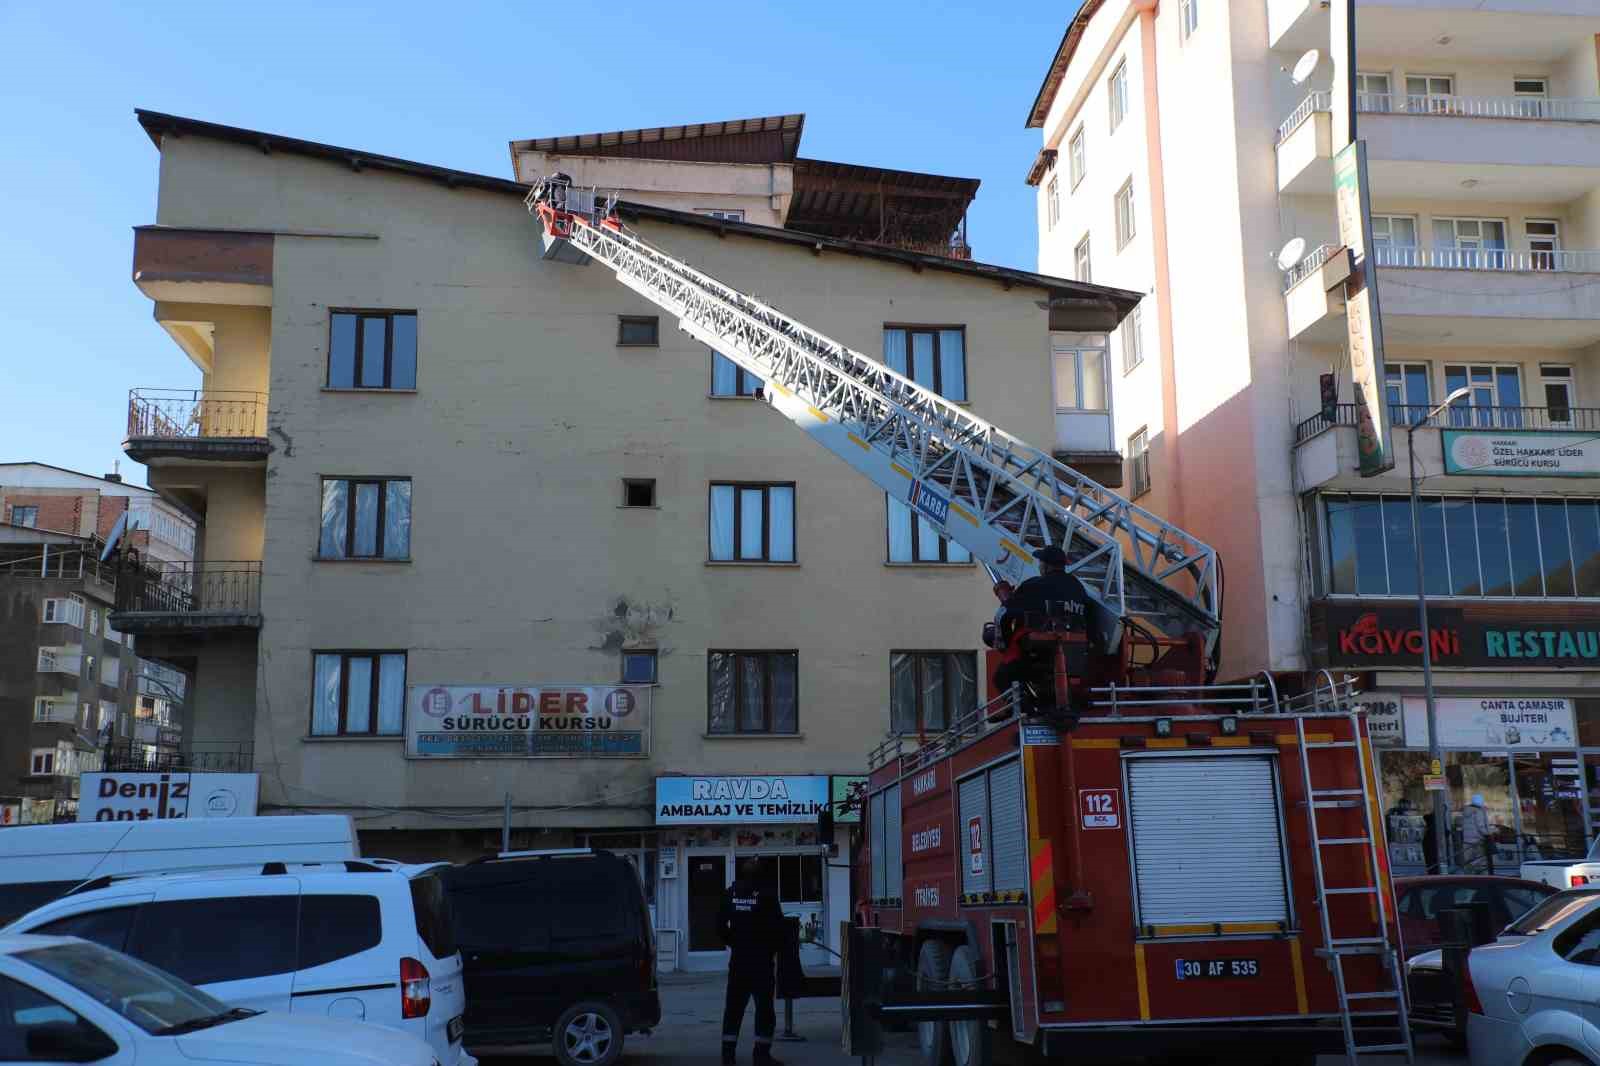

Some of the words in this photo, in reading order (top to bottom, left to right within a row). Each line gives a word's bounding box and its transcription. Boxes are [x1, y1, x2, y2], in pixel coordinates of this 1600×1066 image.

[1492, 447, 1515, 456] ÖZEL
[1494, 457, 1530, 468] SÜRÜCÜ
[1531, 458, 1561, 468] KURSU
[472, 689, 590, 714] LİDER
[1480, 700, 1516, 712] ÇANTA
[1518, 700, 1566, 712] ÇAMAŞIR
[443, 715, 530, 731] SÜRÜCÜ
[539, 716, 612, 731] KURSU
[1500, 713, 1548, 724] BUJİTERİ
[98, 775, 187, 801] Deniz
[692, 778, 789, 801] RAVDA
[660, 804, 731, 817] AMBALAJ
[735, 804, 754, 817] VE
[759, 800, 821, 817] TEMİZLİK
[1086, 793, 1113, 813] 112
[1184, 961, 1201, 976] 30
[1208, 961, 1225, 976] AF
[1231, 960, 1257, 976] 535
